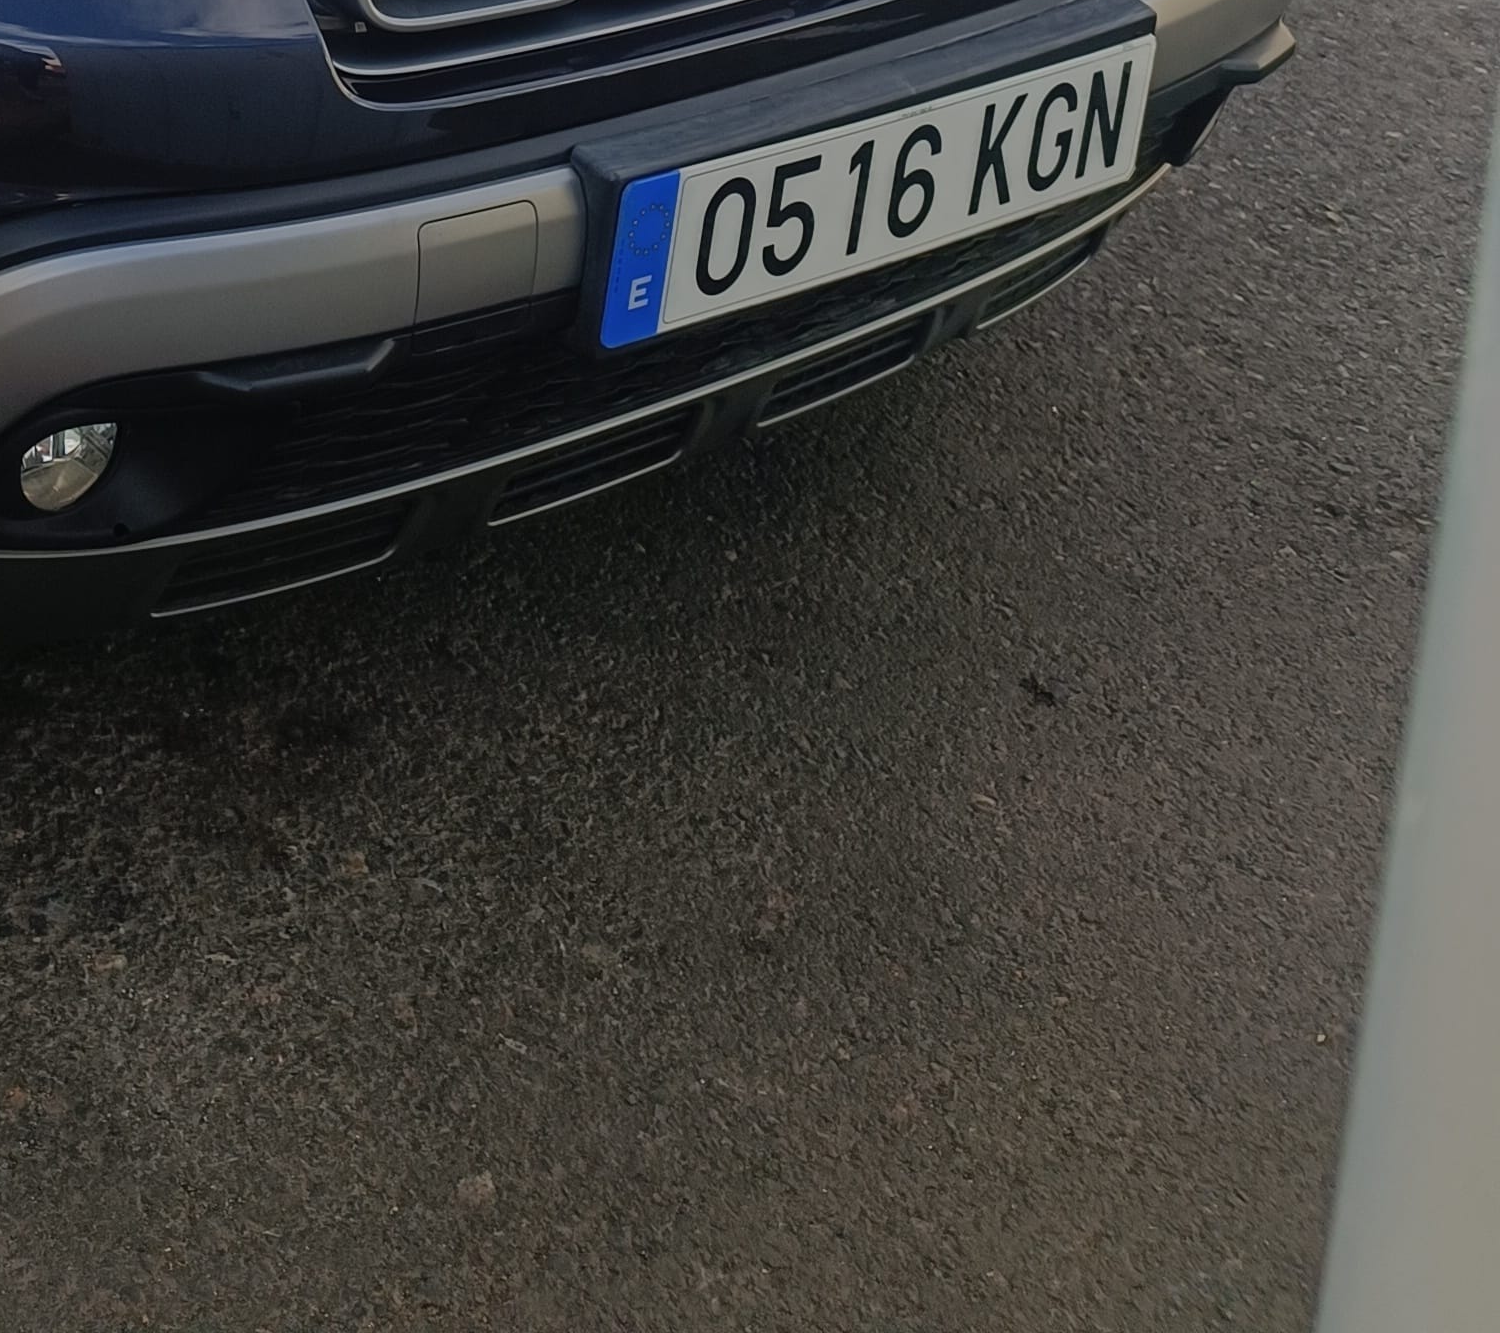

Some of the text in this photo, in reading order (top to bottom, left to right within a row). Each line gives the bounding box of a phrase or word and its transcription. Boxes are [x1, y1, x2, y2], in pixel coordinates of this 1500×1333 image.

[627, 60, 1133, 311] E 0516 KGN
